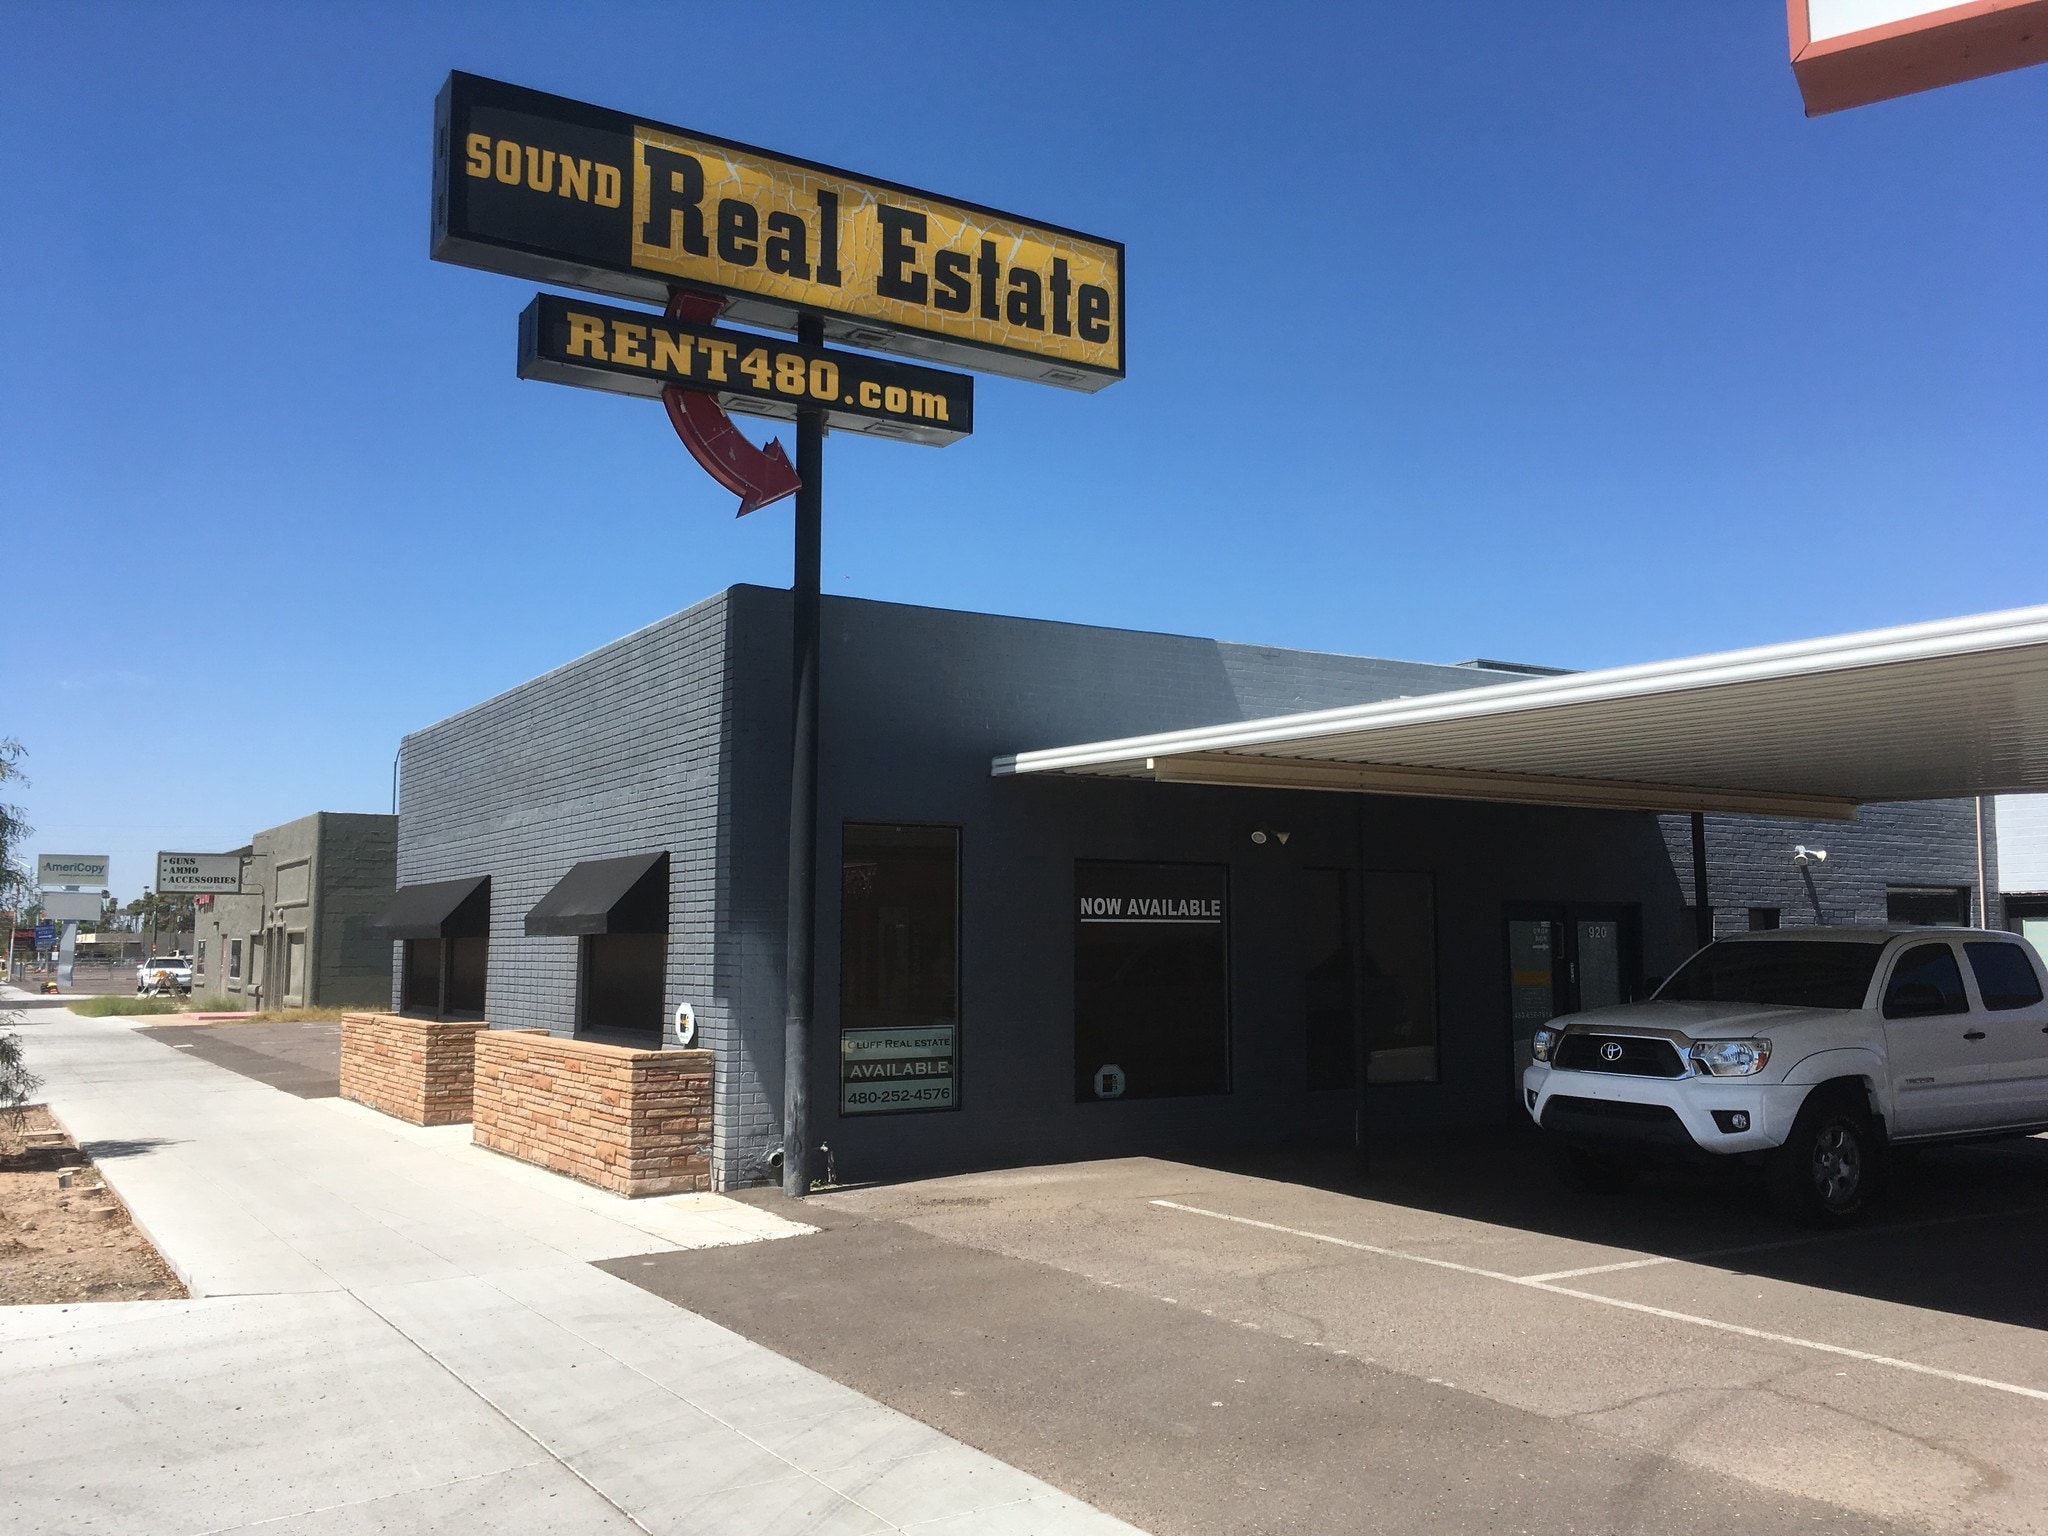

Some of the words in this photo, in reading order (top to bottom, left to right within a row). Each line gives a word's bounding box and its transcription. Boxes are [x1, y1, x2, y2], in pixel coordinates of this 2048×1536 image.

[466, 133, 621, 209] SOUND
[642, 144, 842, 288] Real
[877, 203, 1110, 345] Estate
[566, 312, 949, 422] RENT480.com
[43, 861, 105, 874] AmeriCopy
[168, 857, 196, 865] GUNS
[168, 866, 199, 874] AMMO
[168, 875, 237, 884] ACCESSORIES
[1080, 897, 1122, 915] NOW
[1127, 899, 1221, 916] AVAILABLE
[1588, 926, 1607, 938] 920
[849, 1061, 949, 1078] AVAILABLE
[847, 1087, 951, 1104] 480-252-4576
